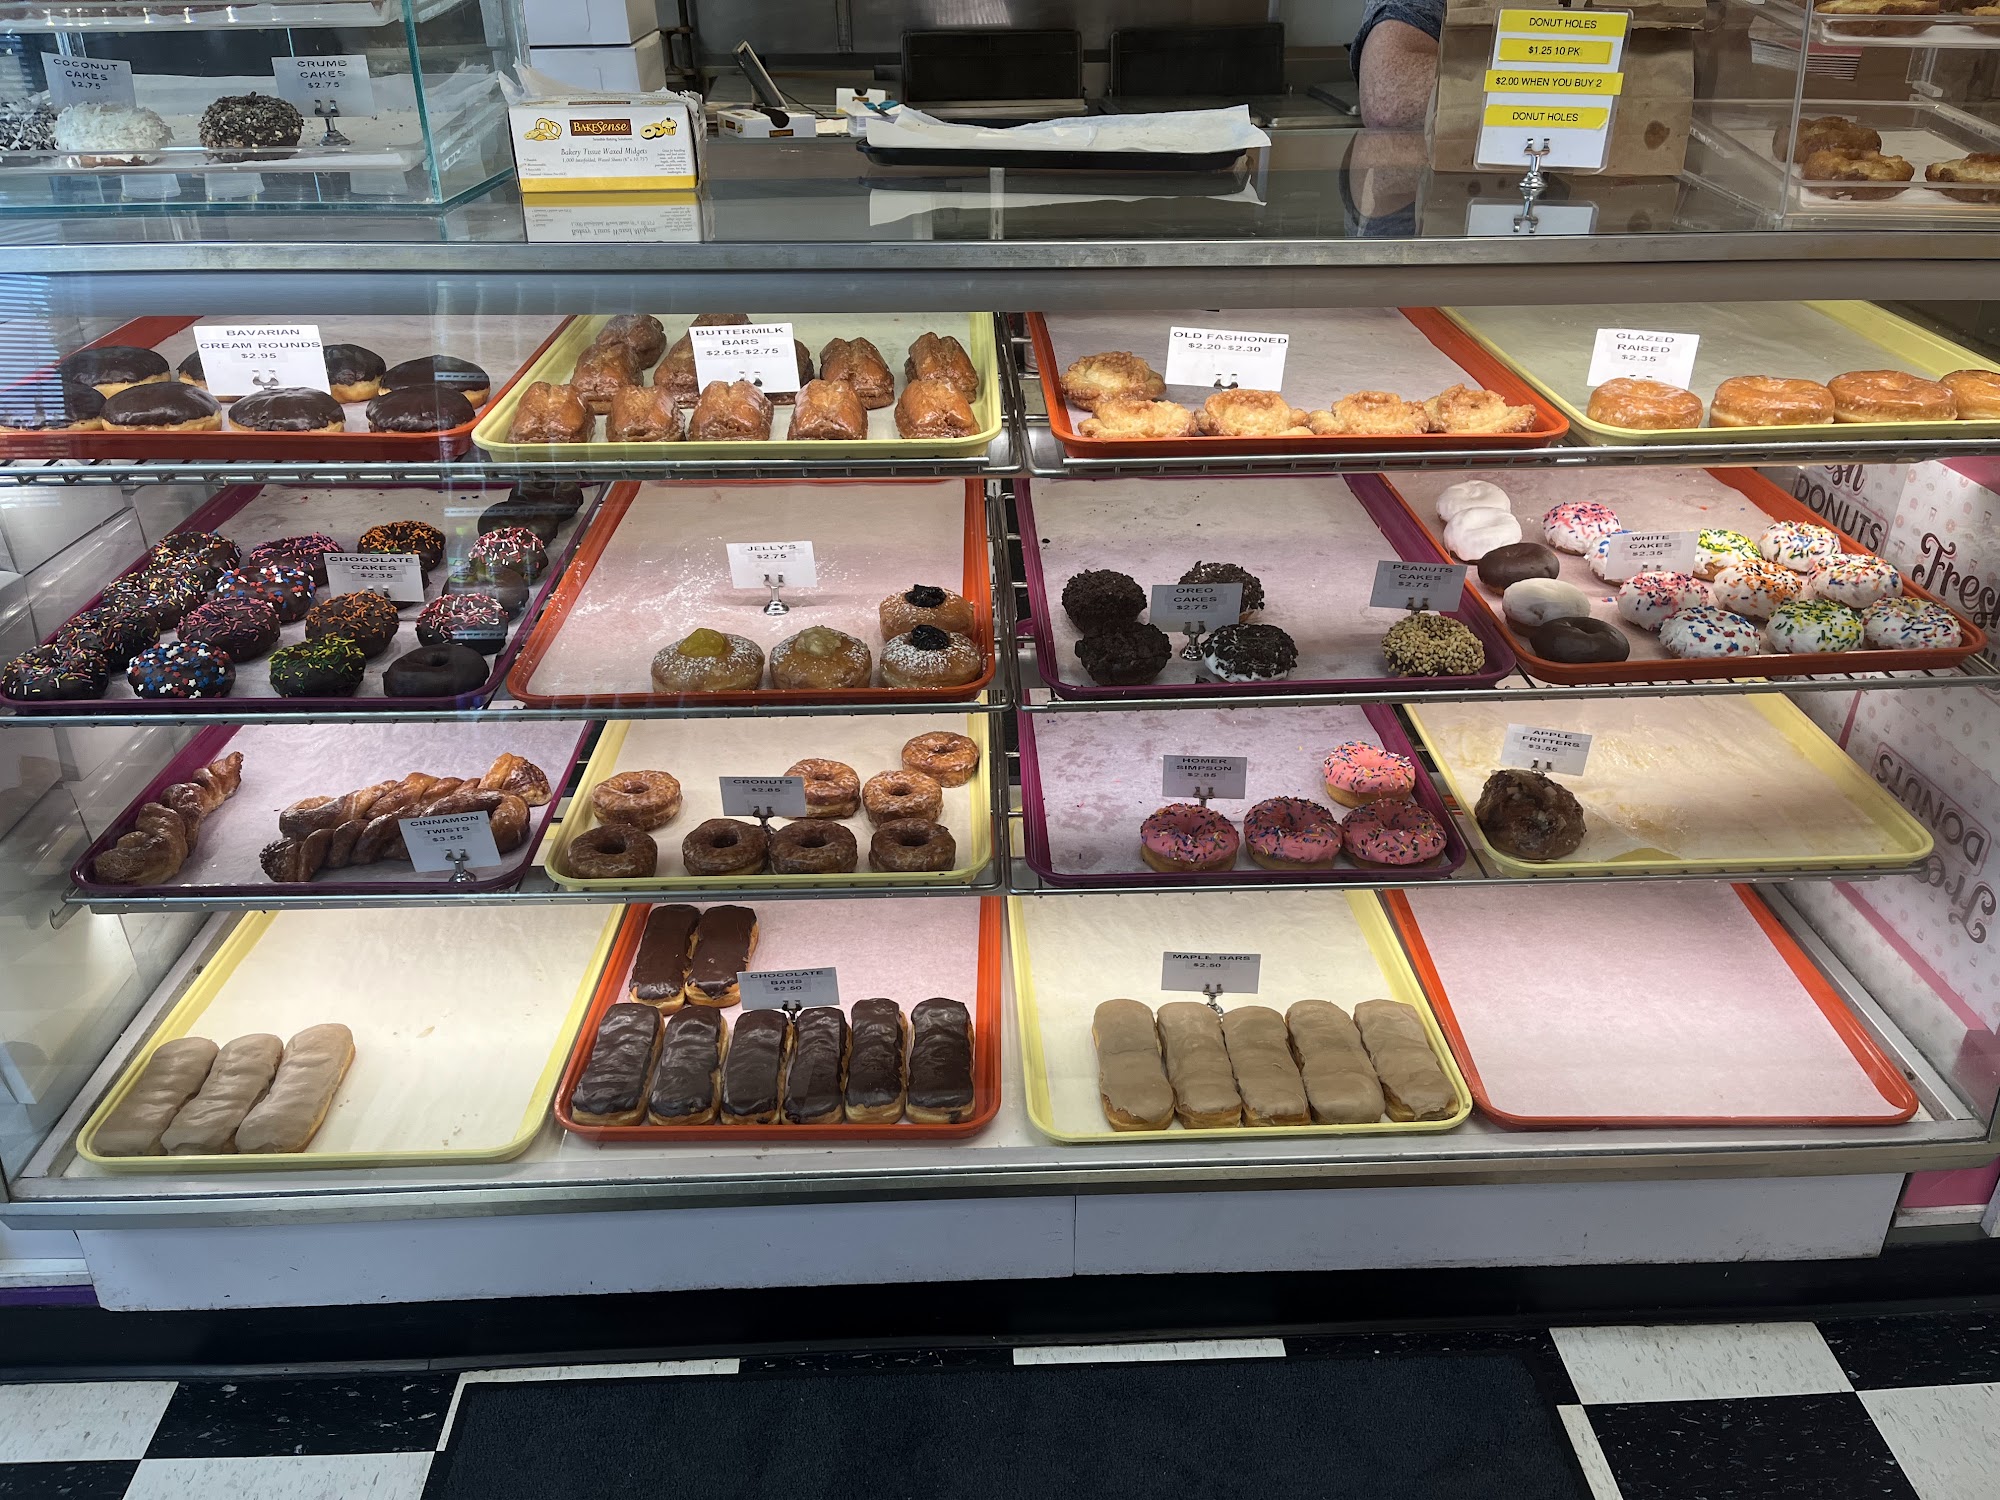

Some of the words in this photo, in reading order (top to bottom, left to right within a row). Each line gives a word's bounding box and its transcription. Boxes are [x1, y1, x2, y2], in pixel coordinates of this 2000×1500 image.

[1530, 17, 1562, 28] DONUT
[1565, 18, 1597, 29] HOLES
[1528, 46, 1552, 56] $1.25
[1555, 46, 1565, 55] 10
[1568, 47, 1580, 56] PK
[54, 58, 117, 70] COCONUT
[65, 70, 108, 81] CAKES
[300, 70, 346, 78] CAKES
[71, 81, 101, 90] $2.75
[1496, 77, 1518, 86] $2.00
[1521, 78, 1548, 87] WHEN
[1552, 78, 1572, 87] YOU
[1575, 79, 1594, 87] BUY
[1596, 79, 1602, 88] 2
[1513, 112, 1545, 121] DONUT
[1547, 112, 1578, 121] HOLES
[561, 148, 581, 157] Bakery
[625, 147, 647, 156] Midgets
[696, 327, 784, 336] BUTTERMILK
[722, 338, 759, 346] BARS
[1174, 331, 1202, 339] OLD
[1207, 333, 1287, 344] FASHIONED
[1616, 333, 1674, 343] GLAZED
[706, 348, 779, 356] $2.65-$2.75
[1188, 342, 1261, 352] $2.20-$2.30
[1617, 344, 1670, 353] RAISED
[1622, 354, 1656, 362] $2.35
[1794, 474, 1883, 552] DONUTS
[747, 544, 796, 552] JELLY'S
[1392, 565, 1453, 573] PEANUTS
[1533, 730, 1572, 739] APPLE
[1522, 736, 1580, 747] FRITTERS
[1876, 754, 1985, 866] DONUTS
[410, 816, 479, 826] CINNAMON
[1928, 854, 1997, 944] Fre
